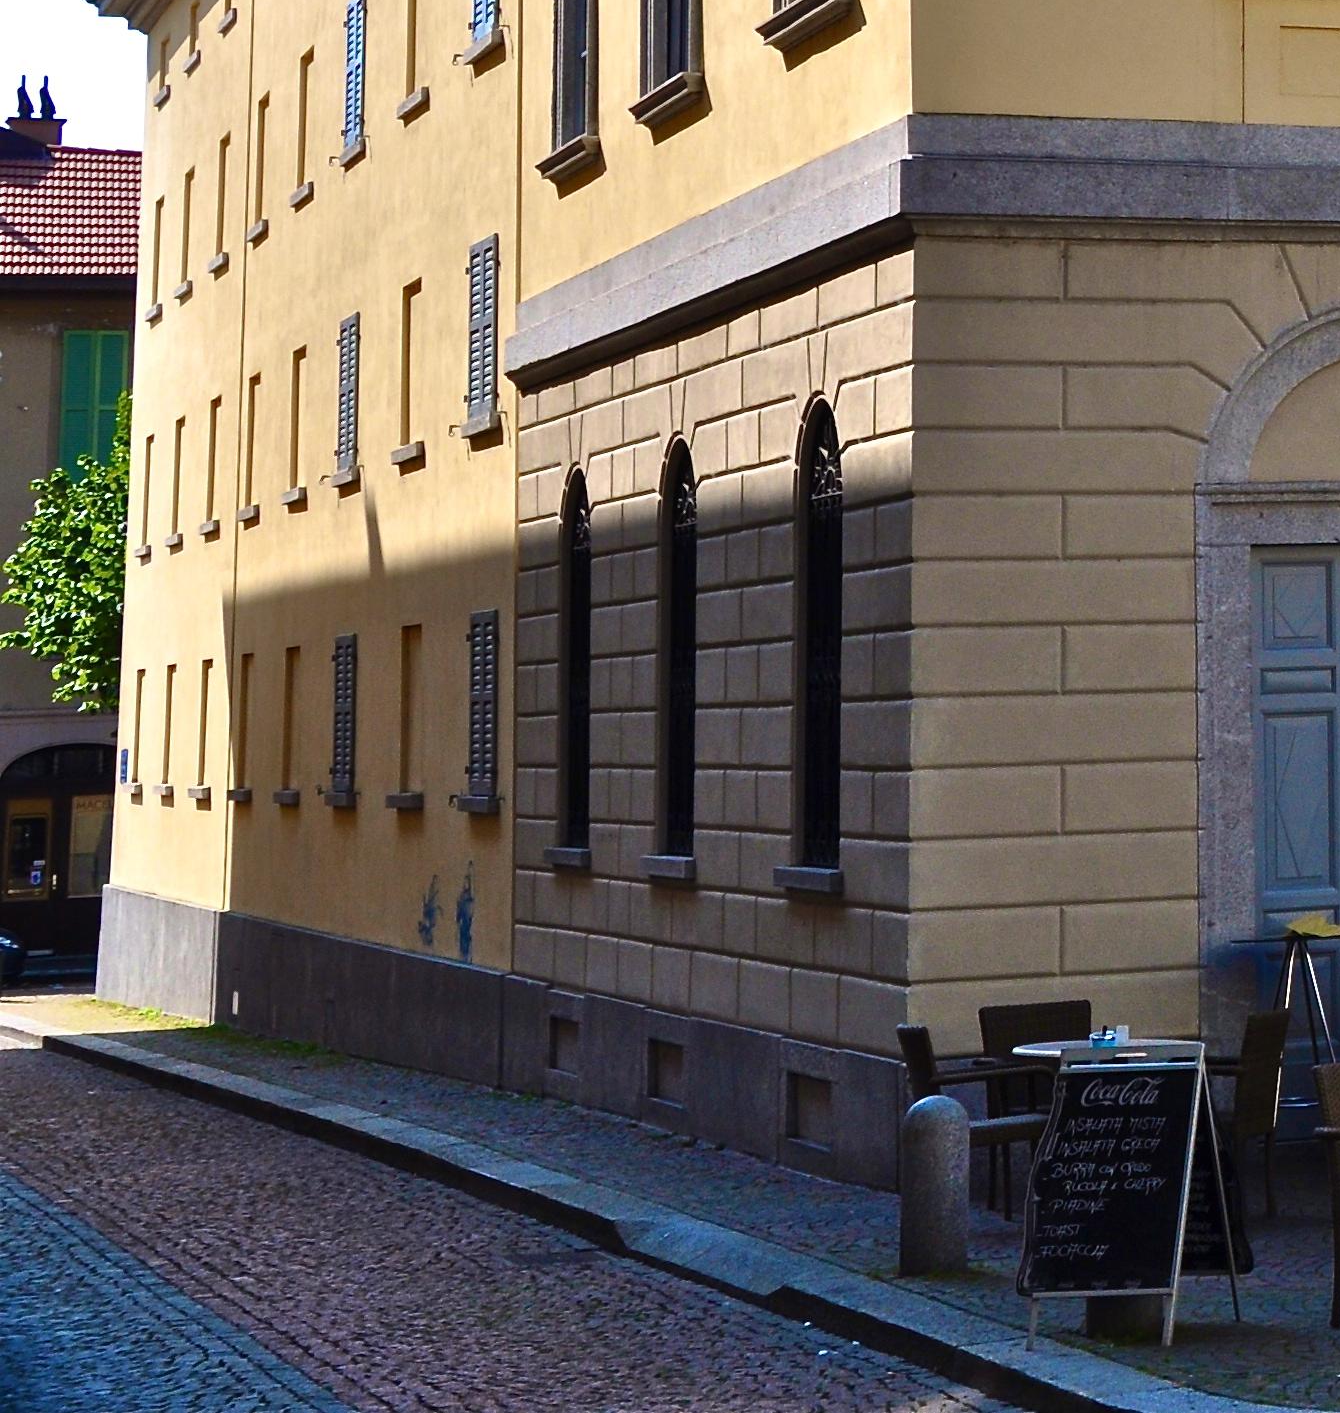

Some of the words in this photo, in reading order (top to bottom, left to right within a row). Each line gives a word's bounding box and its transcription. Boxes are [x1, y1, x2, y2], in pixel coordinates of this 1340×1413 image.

[1065, 1117, 1124, 1136] INSALATA
[1129, 1117, 1167, 1135] MISTA
[1056, 1139, 1116, 1158] INSALATA
[1121, 1138, 1161, 1155] GRECA
